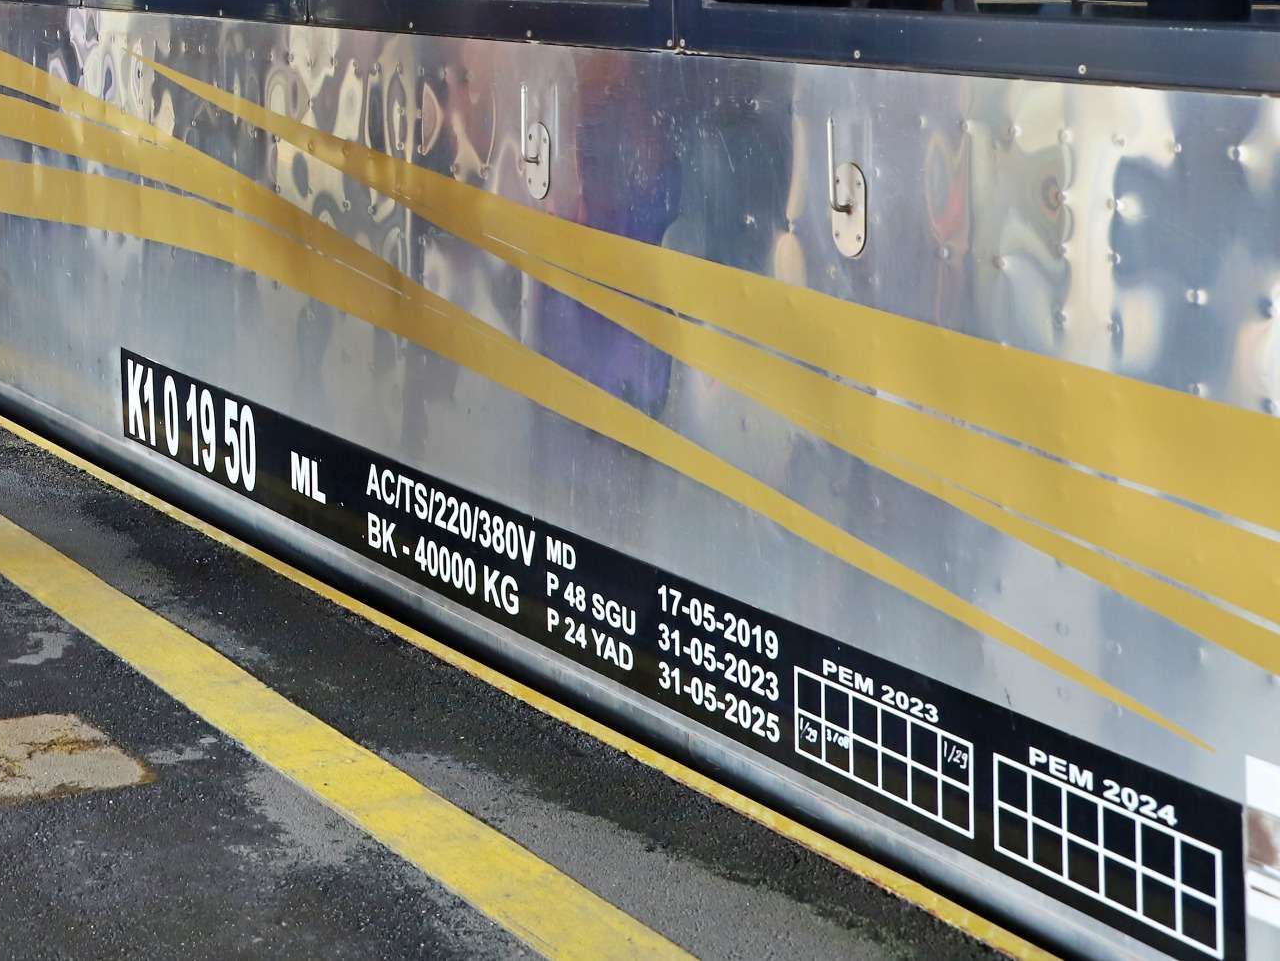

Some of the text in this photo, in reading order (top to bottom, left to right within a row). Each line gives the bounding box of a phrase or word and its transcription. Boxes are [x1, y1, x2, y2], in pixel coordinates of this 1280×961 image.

[127, 358, 256, 492] K1 0 19 50
[290, 450, 327, 505] ML
[366, 463, 536, 567] AC/TS/220/380V
[367, 511, 397, 558] BK
[414, 536, 477, 595] 40000
[483, 564, 520, 615] KG
[546, 535, 577, 571] MD
[546, 571, 637, 636] P 48 SGU
[547, 606, 634, 671] P 24 YAD
[657, 584, 779, 660] 17-05-2019
[657, 622, 780, 702] 31-05-2023
[822, 658, 940, 723] PEM 2023
[657, 661, 780, 743] 31-05-2025
[943, 740, 969, 770] 1/29
[1028, 746, 1179, 827] PEM 2024
